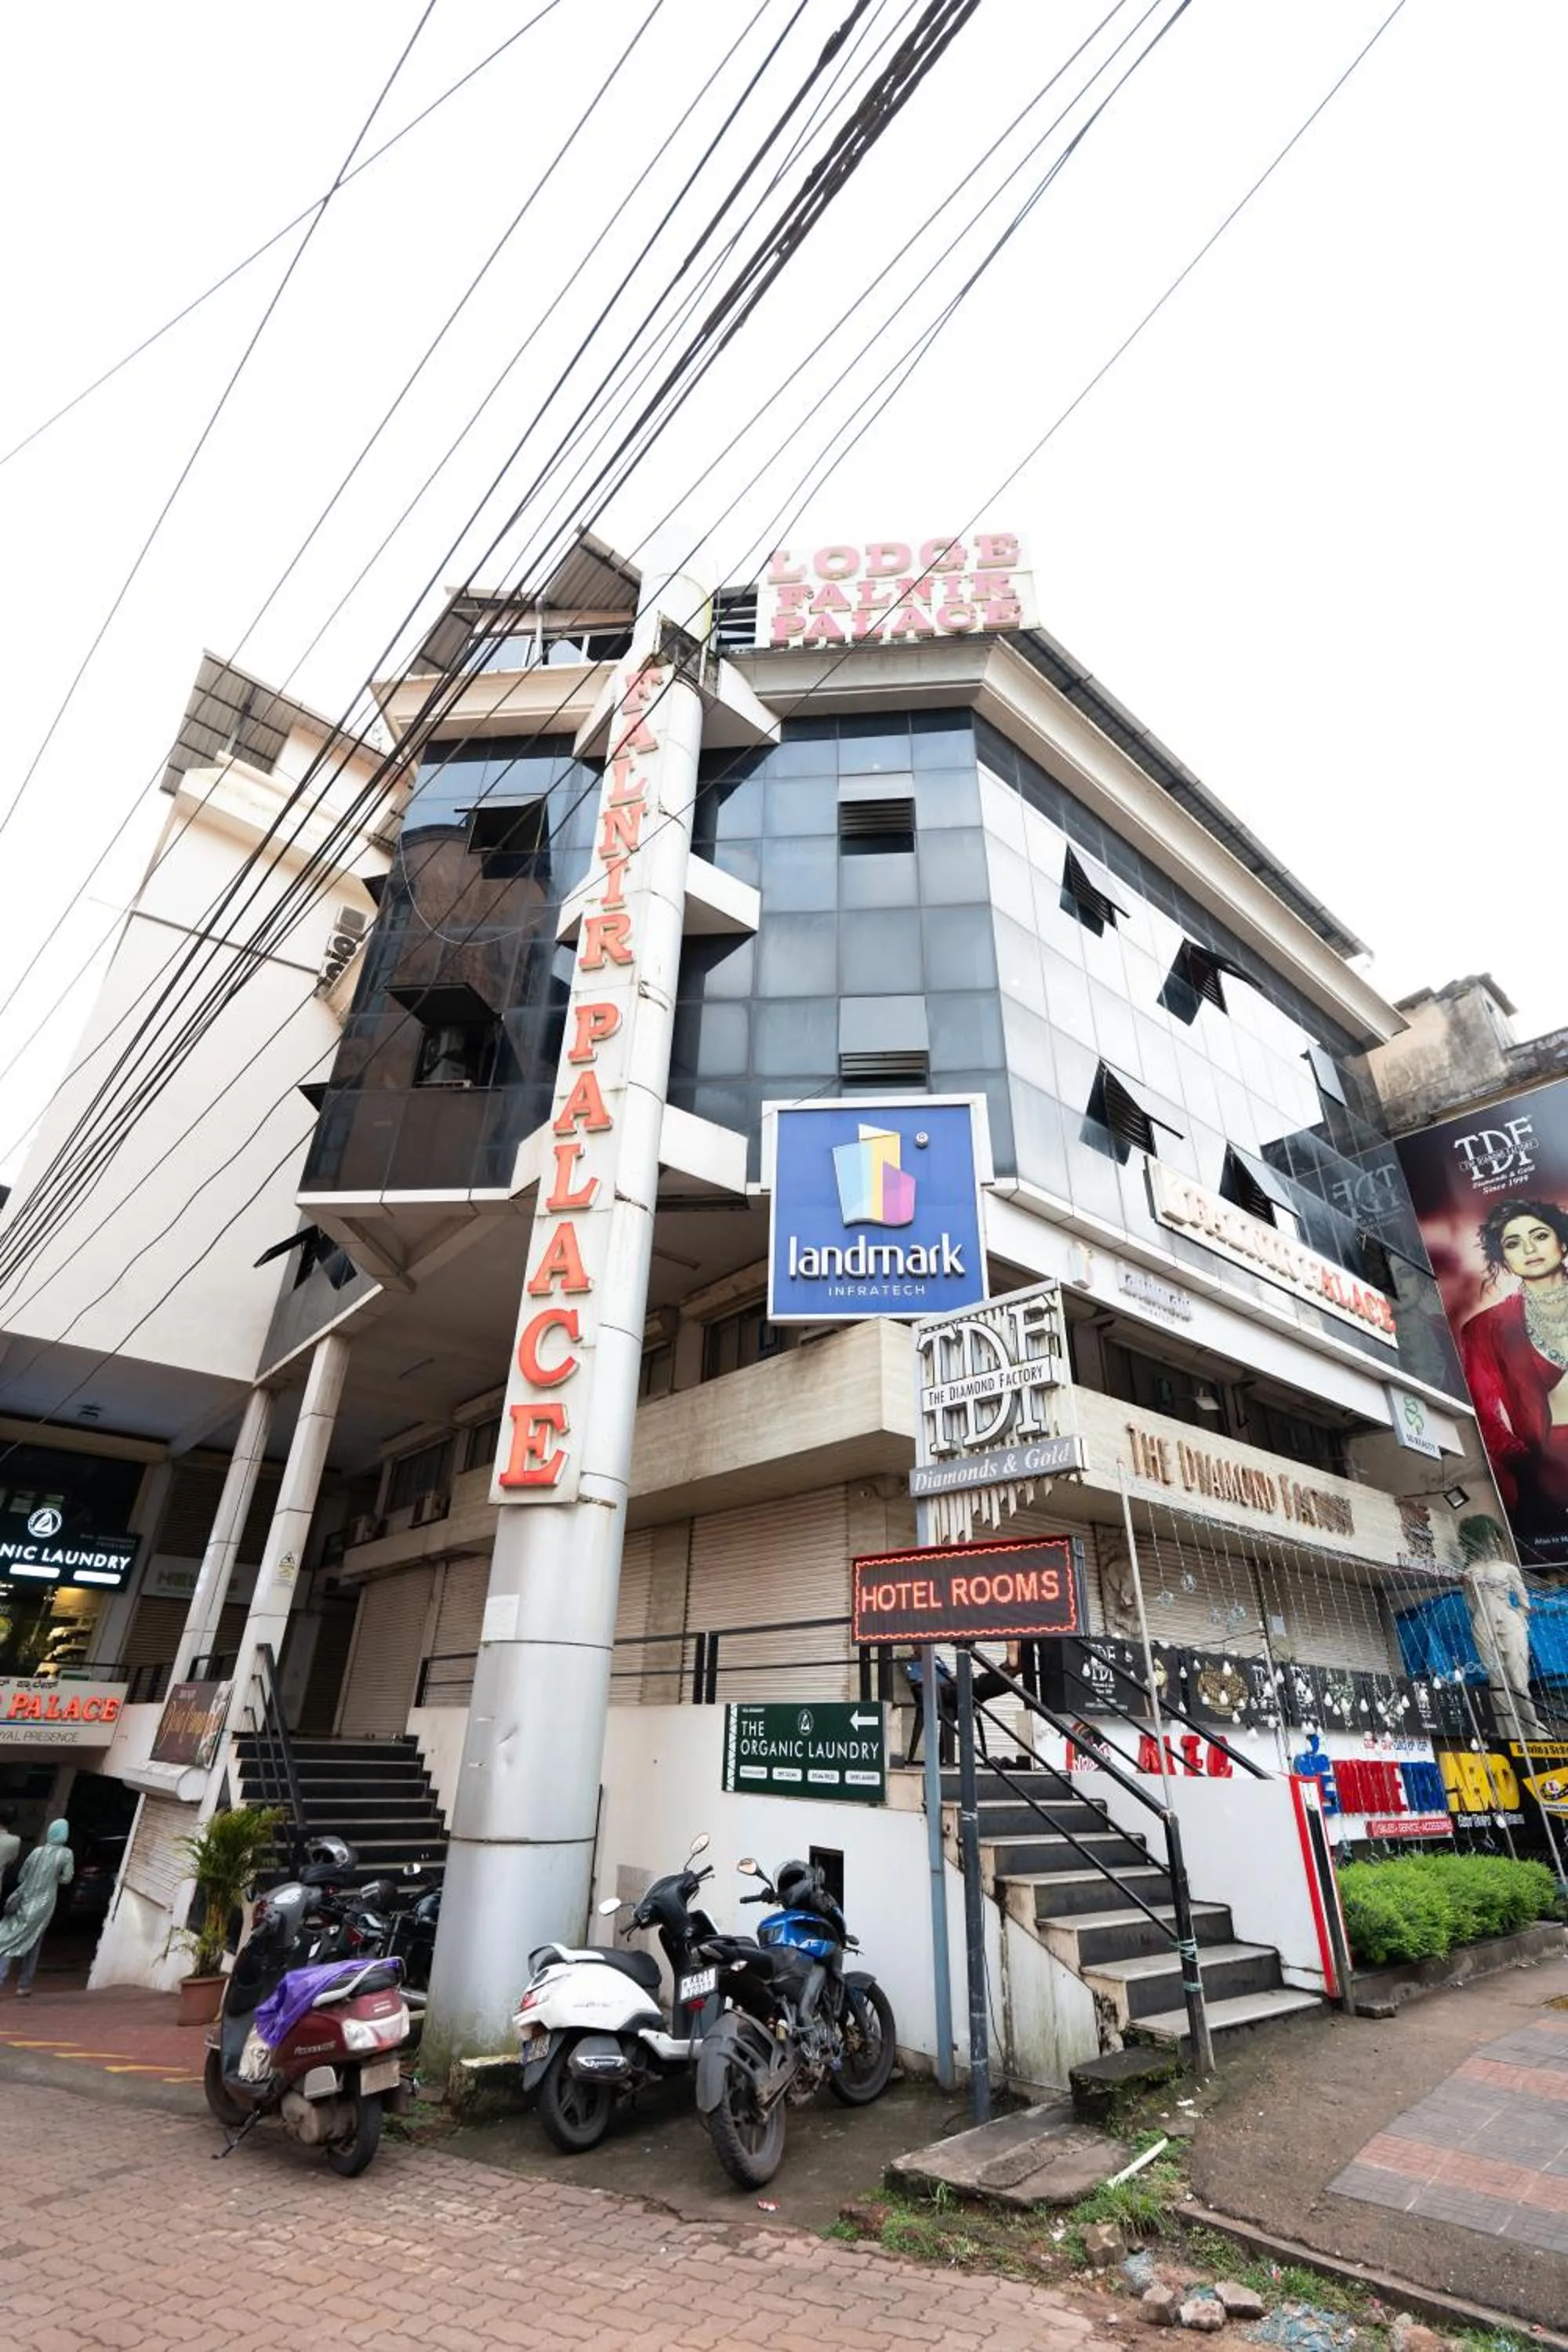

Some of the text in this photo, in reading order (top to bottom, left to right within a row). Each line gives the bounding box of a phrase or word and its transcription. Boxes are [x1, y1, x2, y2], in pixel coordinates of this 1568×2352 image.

[768, 532, 1020, 585] LODGE
[776, 571, 1018, 616] PALNIR
[770, 599, 1022, 646] PALACE
[579, 665, 663, 971] PALNIR
[1454, 1114, 1534, 1181] TDF
[498, 1002, 623, 1488] PALACE
[789, 1232, 966, 1279] landmark
[828, 1283, 926, 1297] INFRATECH
[916, 1294, 1058, 1456] TDF
[928, 1365, 1044, 1406] THE DIAMOND FACTORY
[914, 1440, 1071, 1492] Diamonds & Gold
[1127, 1422, 1174, 1486] THE
[42, 1547, 132, 1571] LAUNDRY
[862, 1570, 1060, 1613] HOTEL ROOMS
[7, 1693, 121, 1722] PALACE
[741, 1721, 765, 1737] THE
[24, 1731, 81, 1742] PRESENCE
[740, 1739, 879, 1760] ORGANIC LAUNDRY
